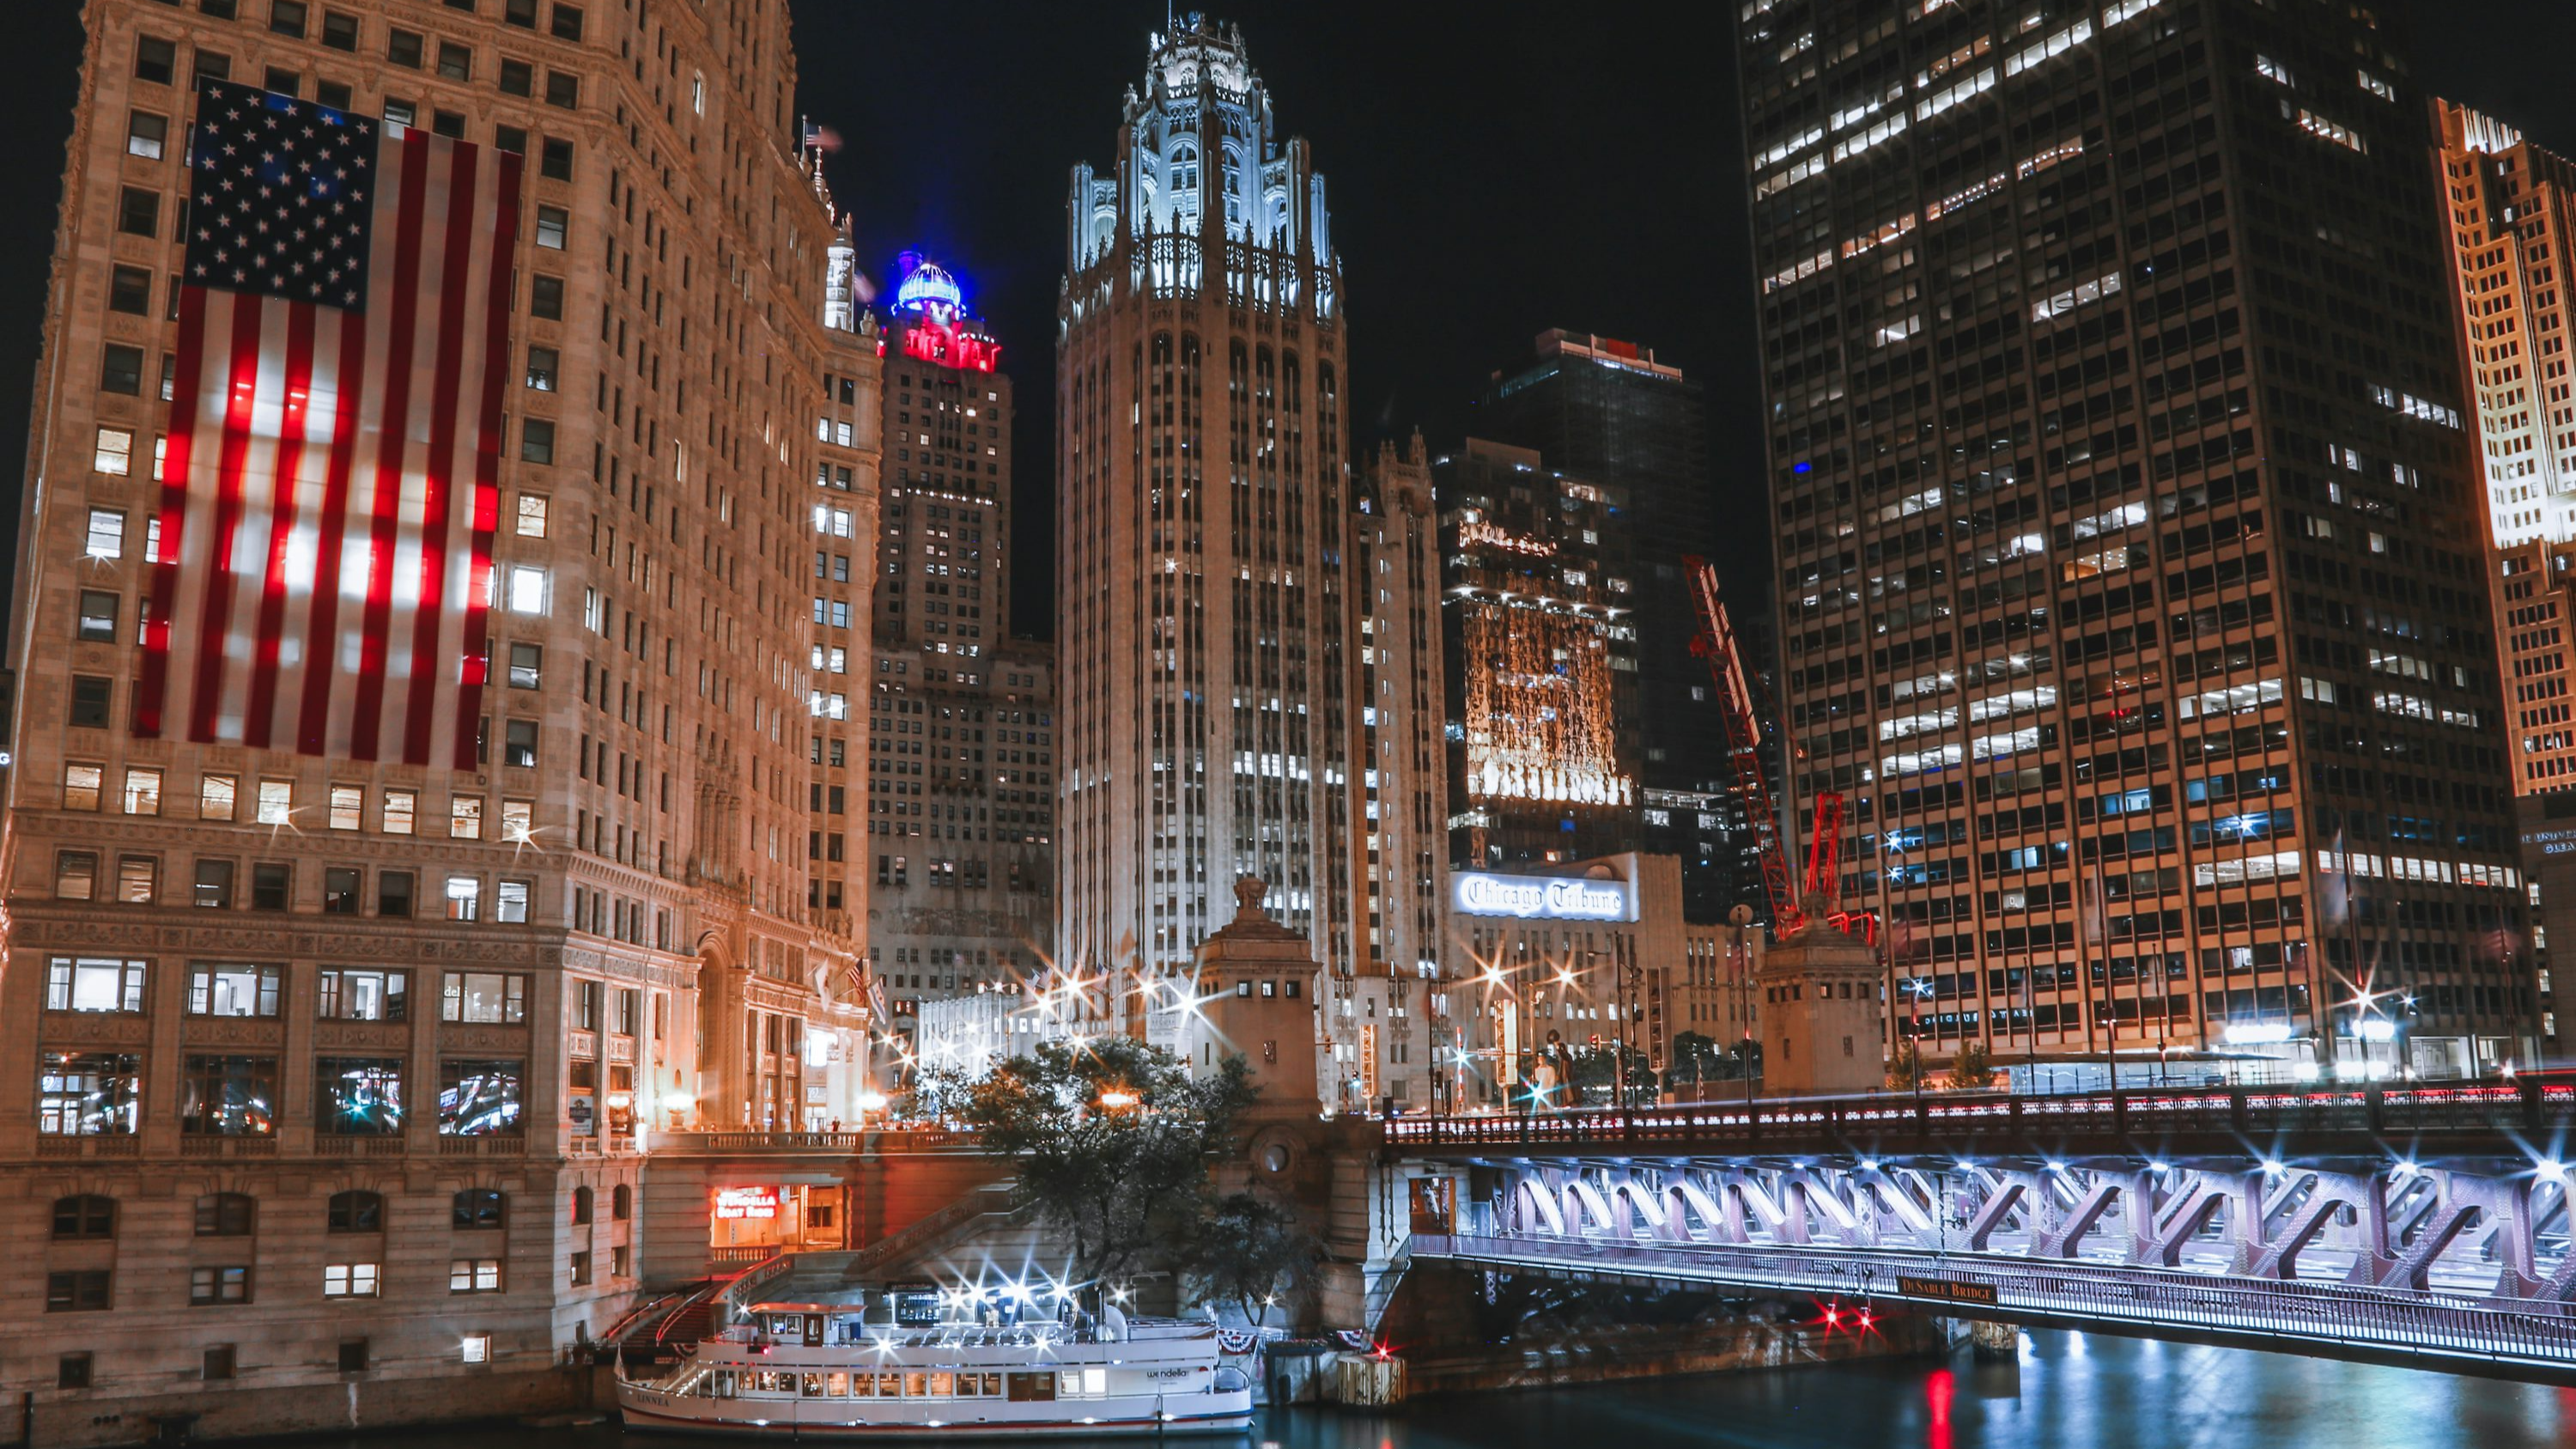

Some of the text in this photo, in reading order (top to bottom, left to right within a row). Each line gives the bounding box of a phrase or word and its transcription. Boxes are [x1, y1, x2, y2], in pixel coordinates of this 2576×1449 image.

[1467, 880, 1623, 910] Chicago Tribune
[716, 1195, 776, 1206] WENDELLA
[1951, 1283, 1991, 1300] BRIDGE
[1147, 1367, 1186, 1378] wendella
